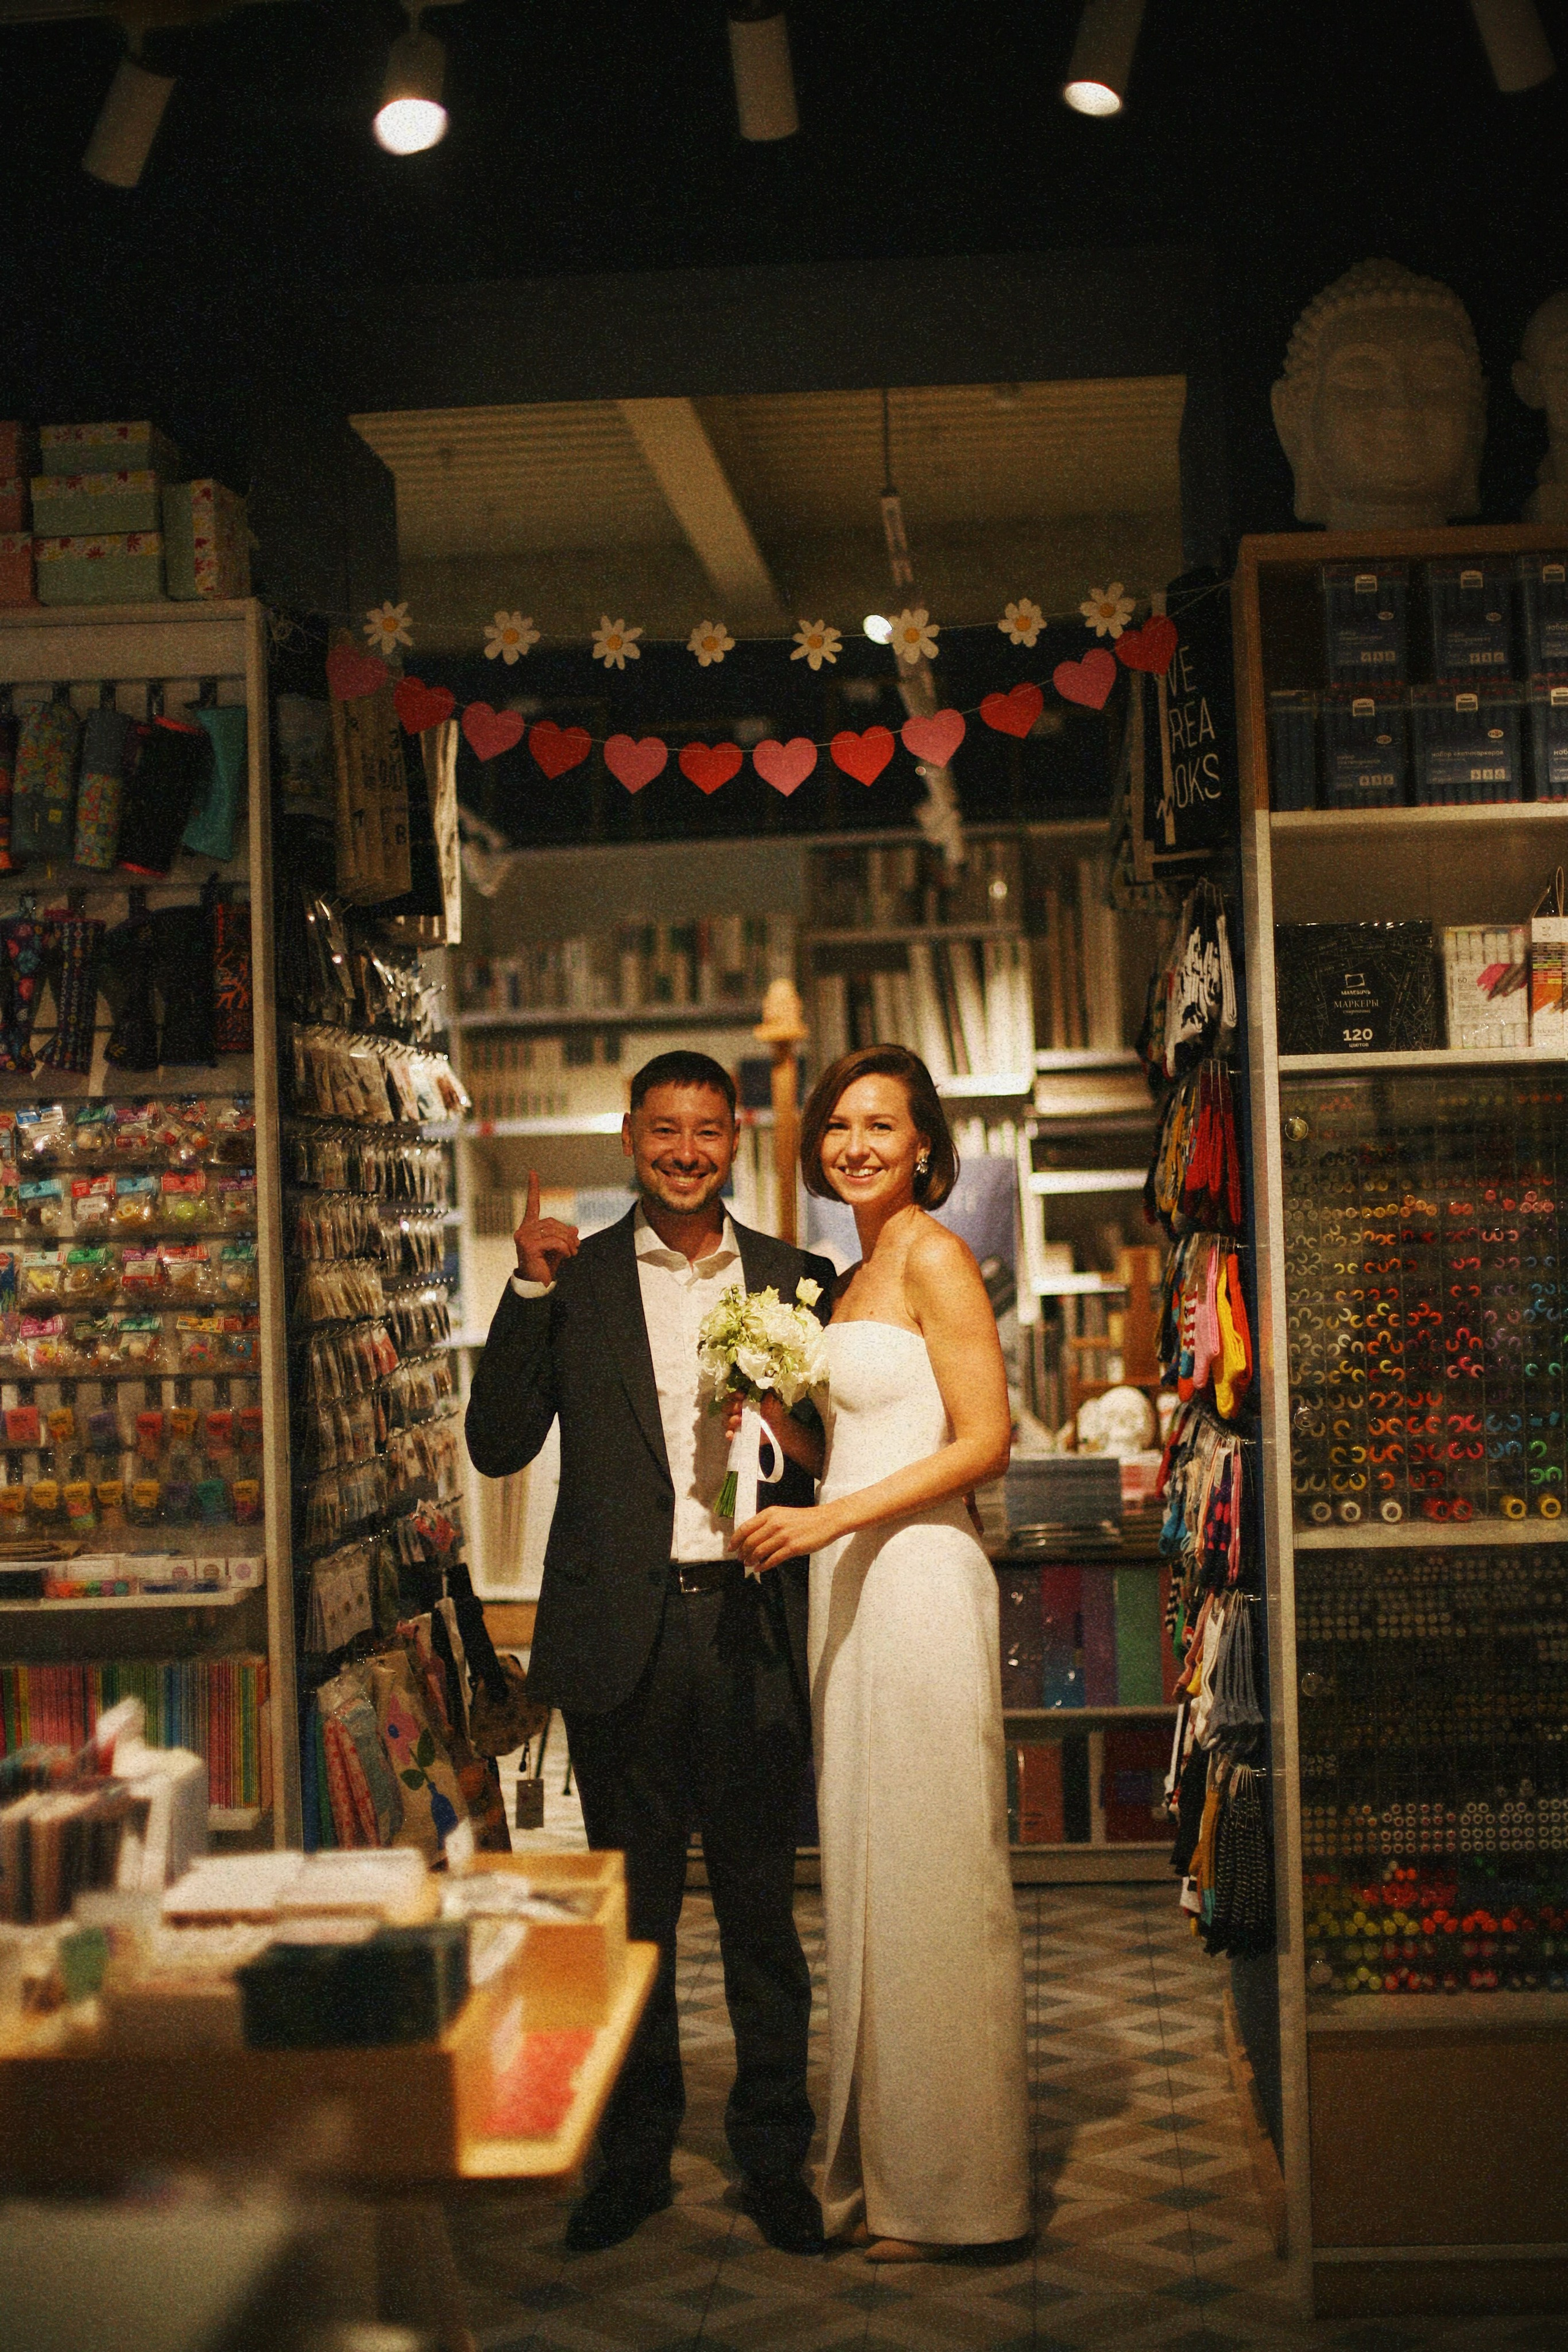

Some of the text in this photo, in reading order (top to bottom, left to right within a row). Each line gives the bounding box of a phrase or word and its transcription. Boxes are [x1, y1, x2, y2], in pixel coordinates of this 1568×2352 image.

[1171, 752, 1222, 810] OKS
[1333, 999, 1379, 1008] МАРКЕРЫ
[1343, 1028, 1374, 1041] 120
